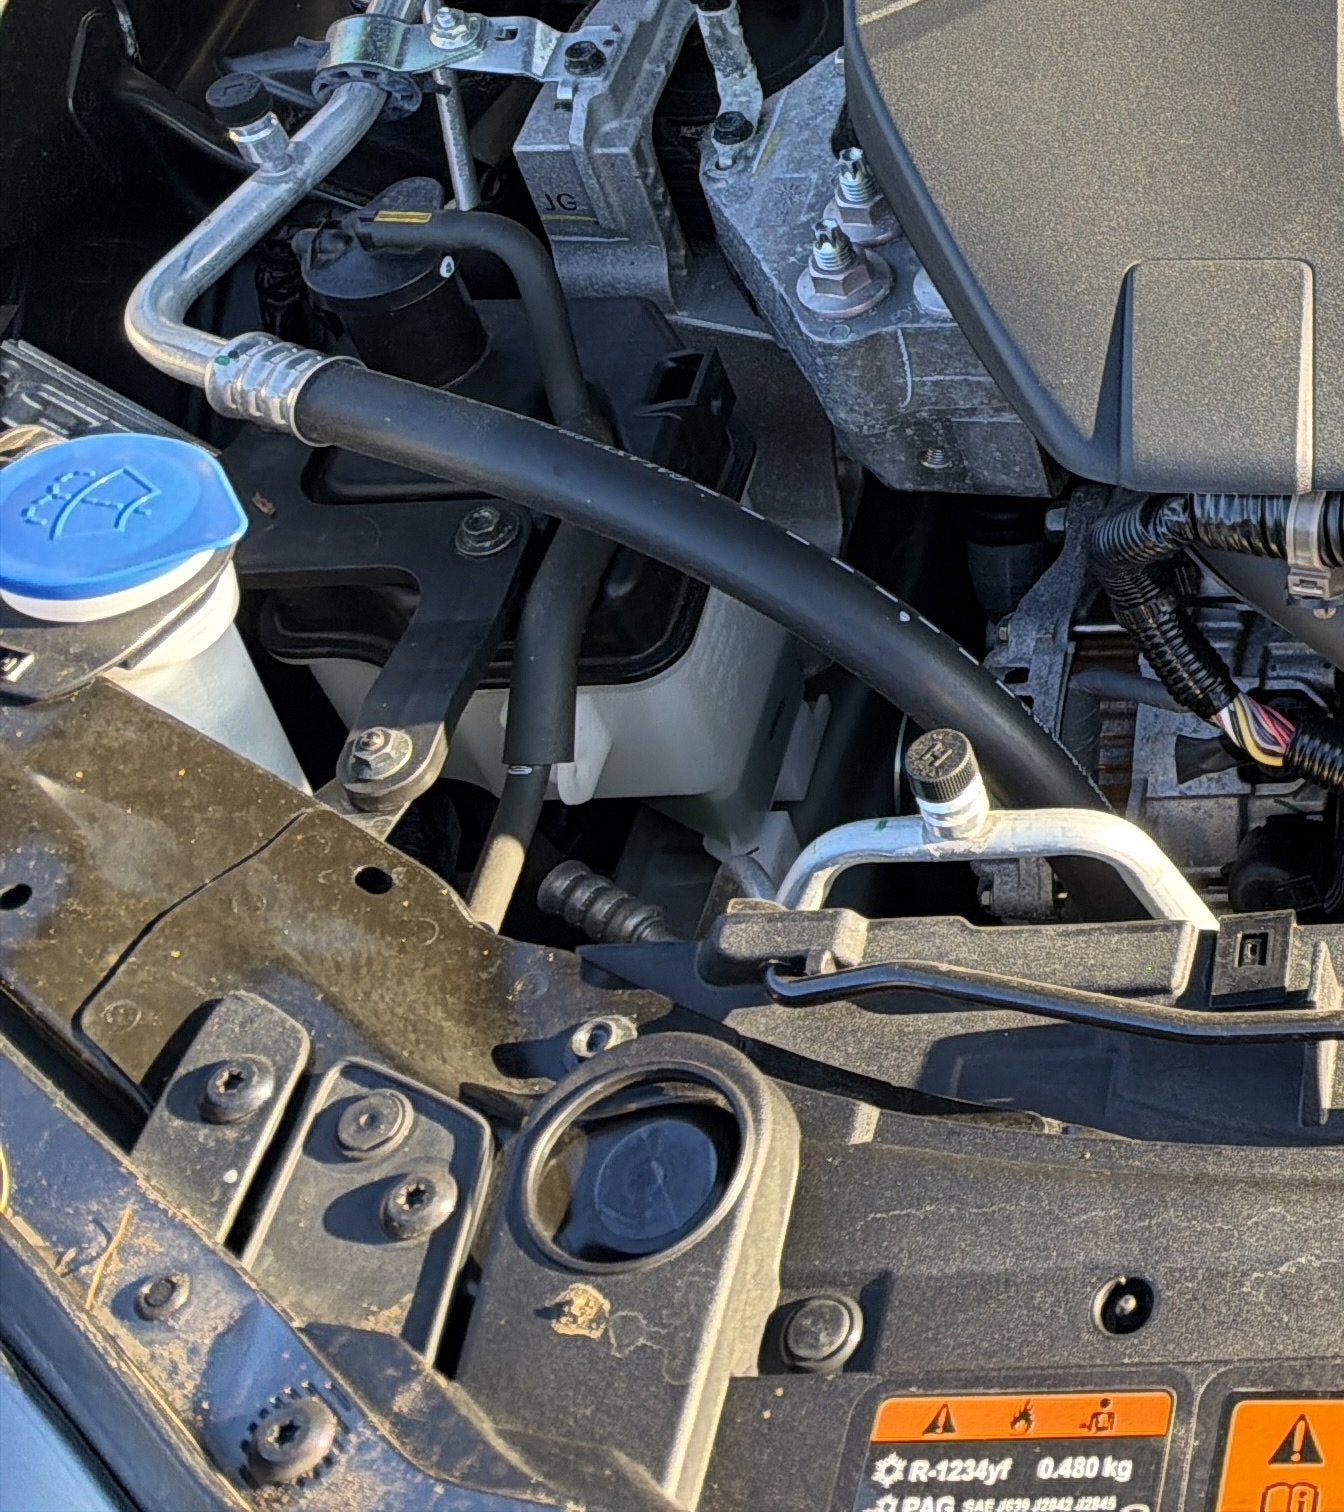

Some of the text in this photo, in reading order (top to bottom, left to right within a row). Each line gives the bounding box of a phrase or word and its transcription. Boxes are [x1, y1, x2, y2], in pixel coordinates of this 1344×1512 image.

[544, 192, 577, 211] JG
[908, 1455, 1133, 1486] R-1234yf 0.480 kg
[902, 1495, 955, 1512] PAG
